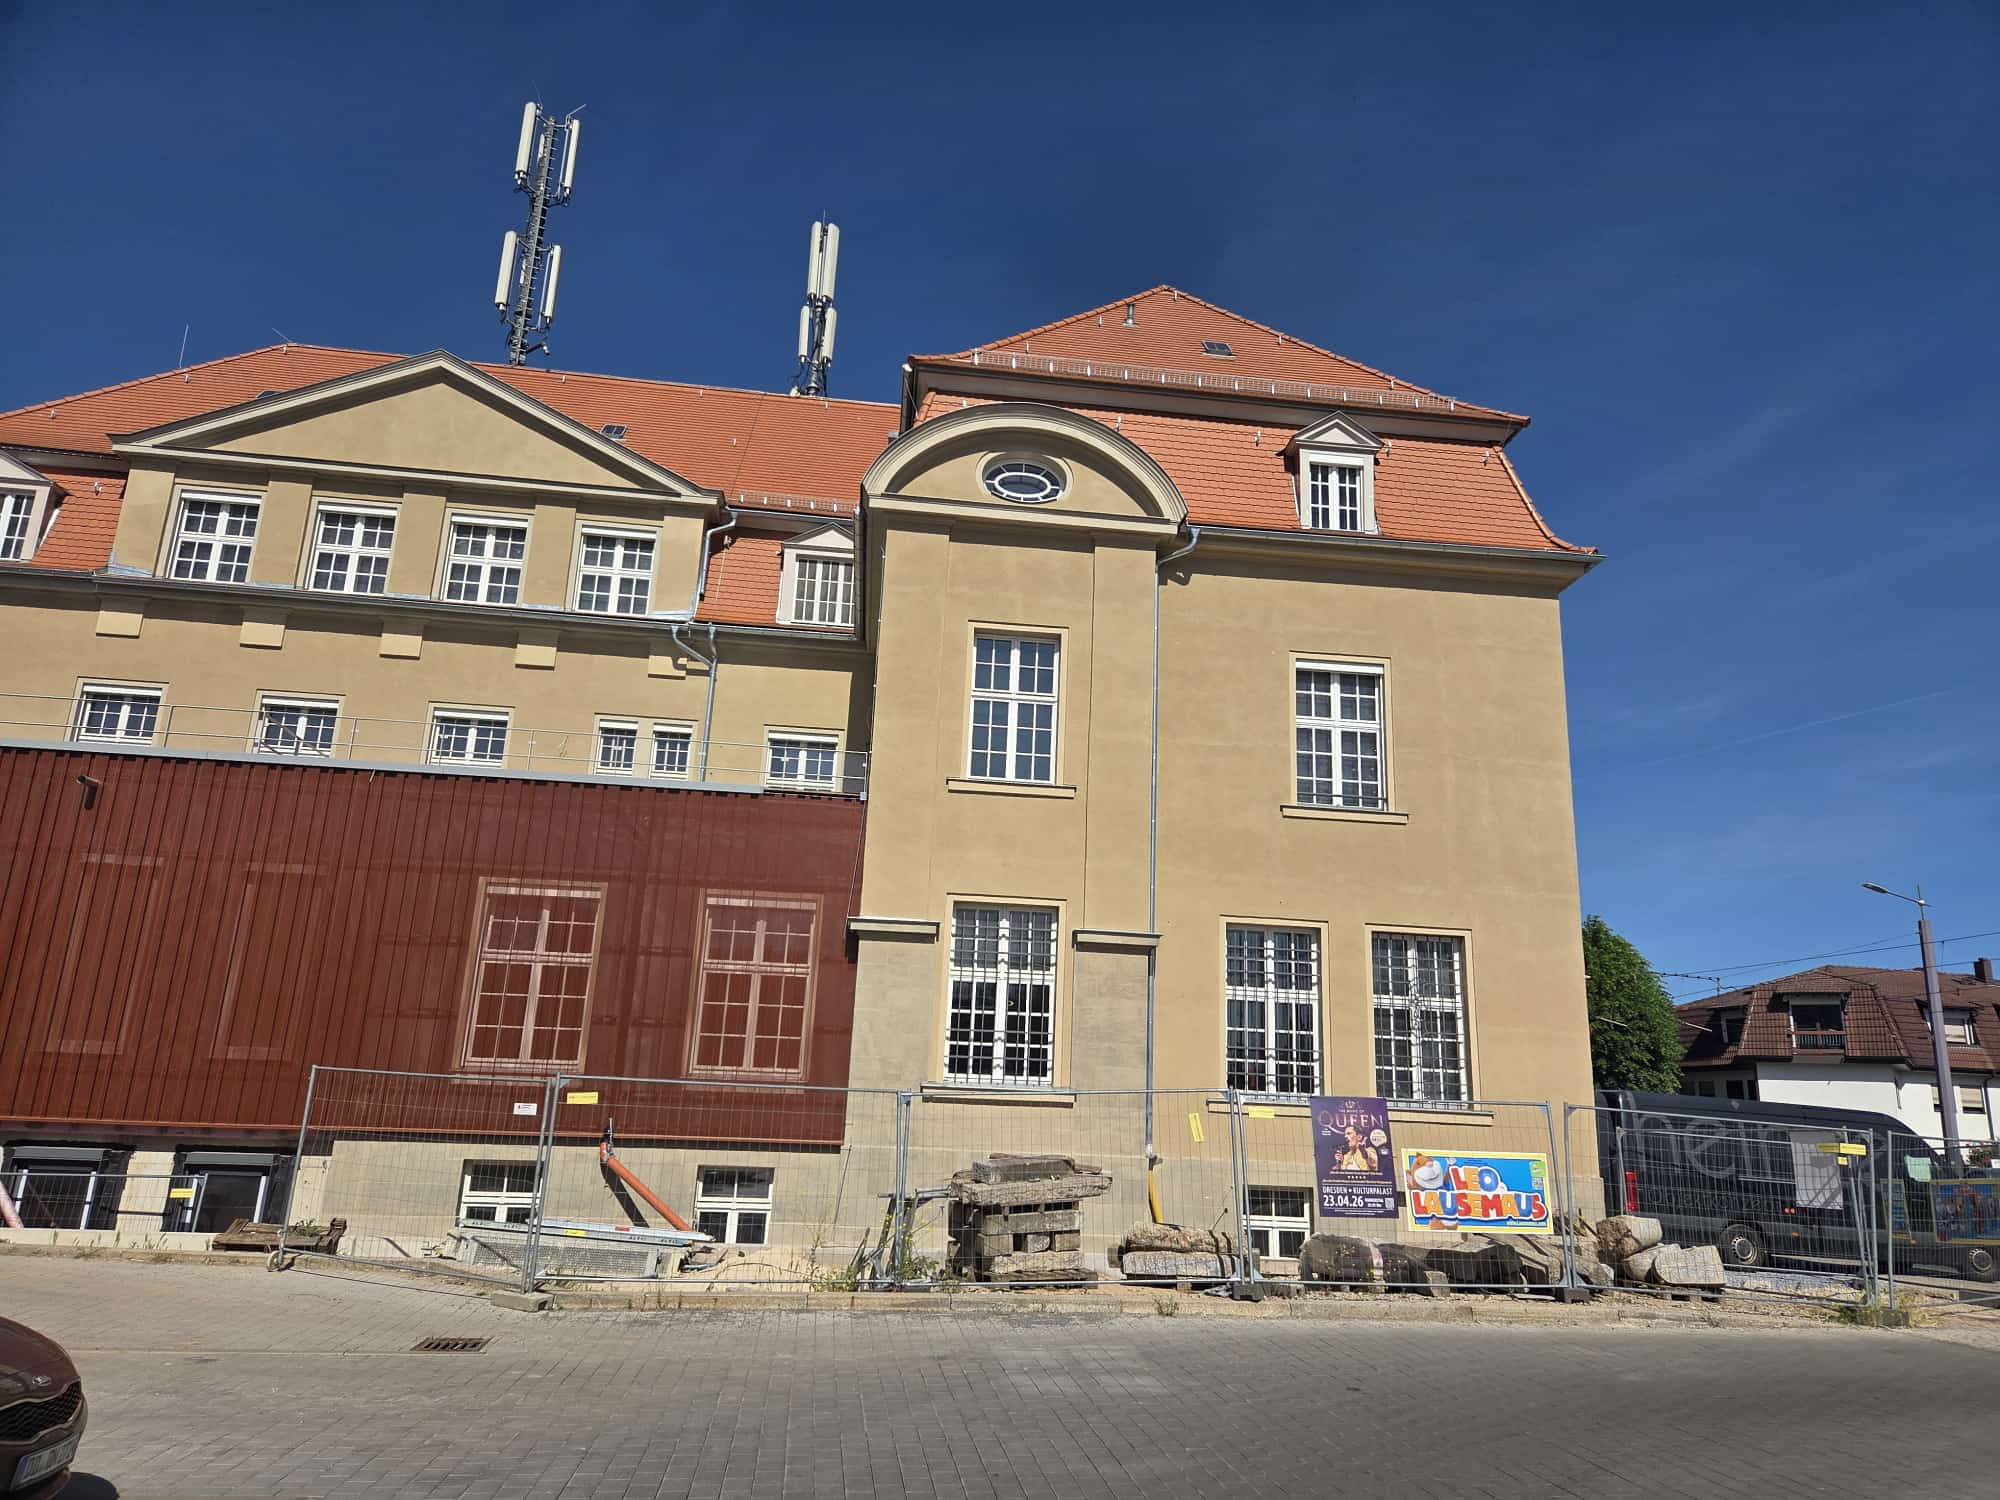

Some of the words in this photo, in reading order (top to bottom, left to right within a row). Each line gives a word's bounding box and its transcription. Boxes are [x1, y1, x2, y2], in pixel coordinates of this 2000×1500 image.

[1319, 1110, 1383, 1134] QUEEN
[1322, 1186, 1347, 1194] DRESDEN
[1353, 1187, 1392, 1195] KULTURPALAST
[1451, 1167, 1499, 1192] LEO
[1323, 1194, 1364, 1207] 23.04.26
[1412, 1191, 1546, 1219] LAUSEMAUS
